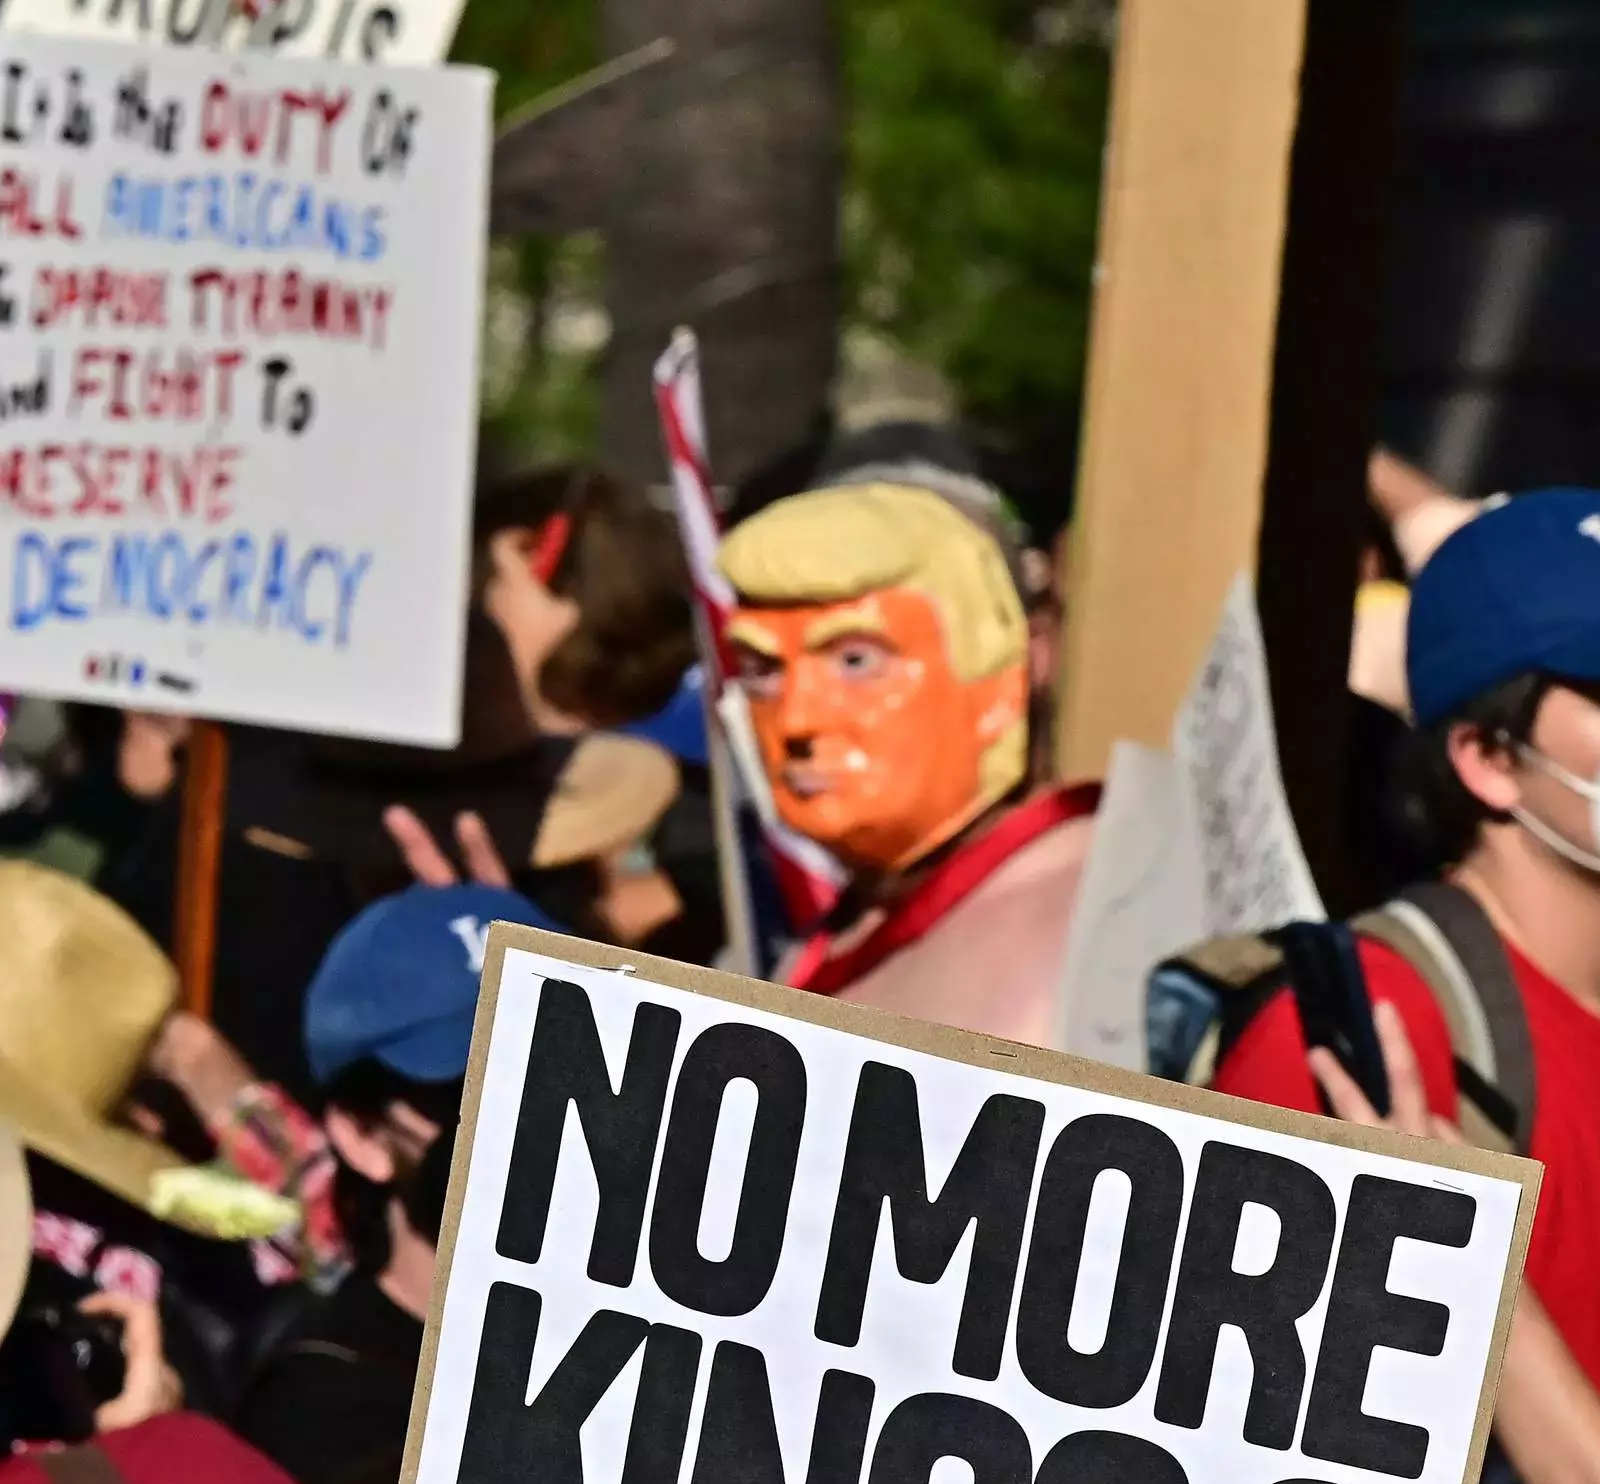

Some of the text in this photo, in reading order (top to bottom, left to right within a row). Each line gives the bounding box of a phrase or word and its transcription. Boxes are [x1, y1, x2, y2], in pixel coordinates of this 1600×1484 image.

[200, 80, 351, 176] DUTY
[106, 169, 388, 262] AMERICANS
[30, 263, 170, 331] OPPOSE
[188, 265, 396, 351] TYRANNY
[68, 350, 249, 426] FIGHT
[7, 528, 375, 649] DEMOCRACY
[496, 977, 1476, 1479] NO MORE
